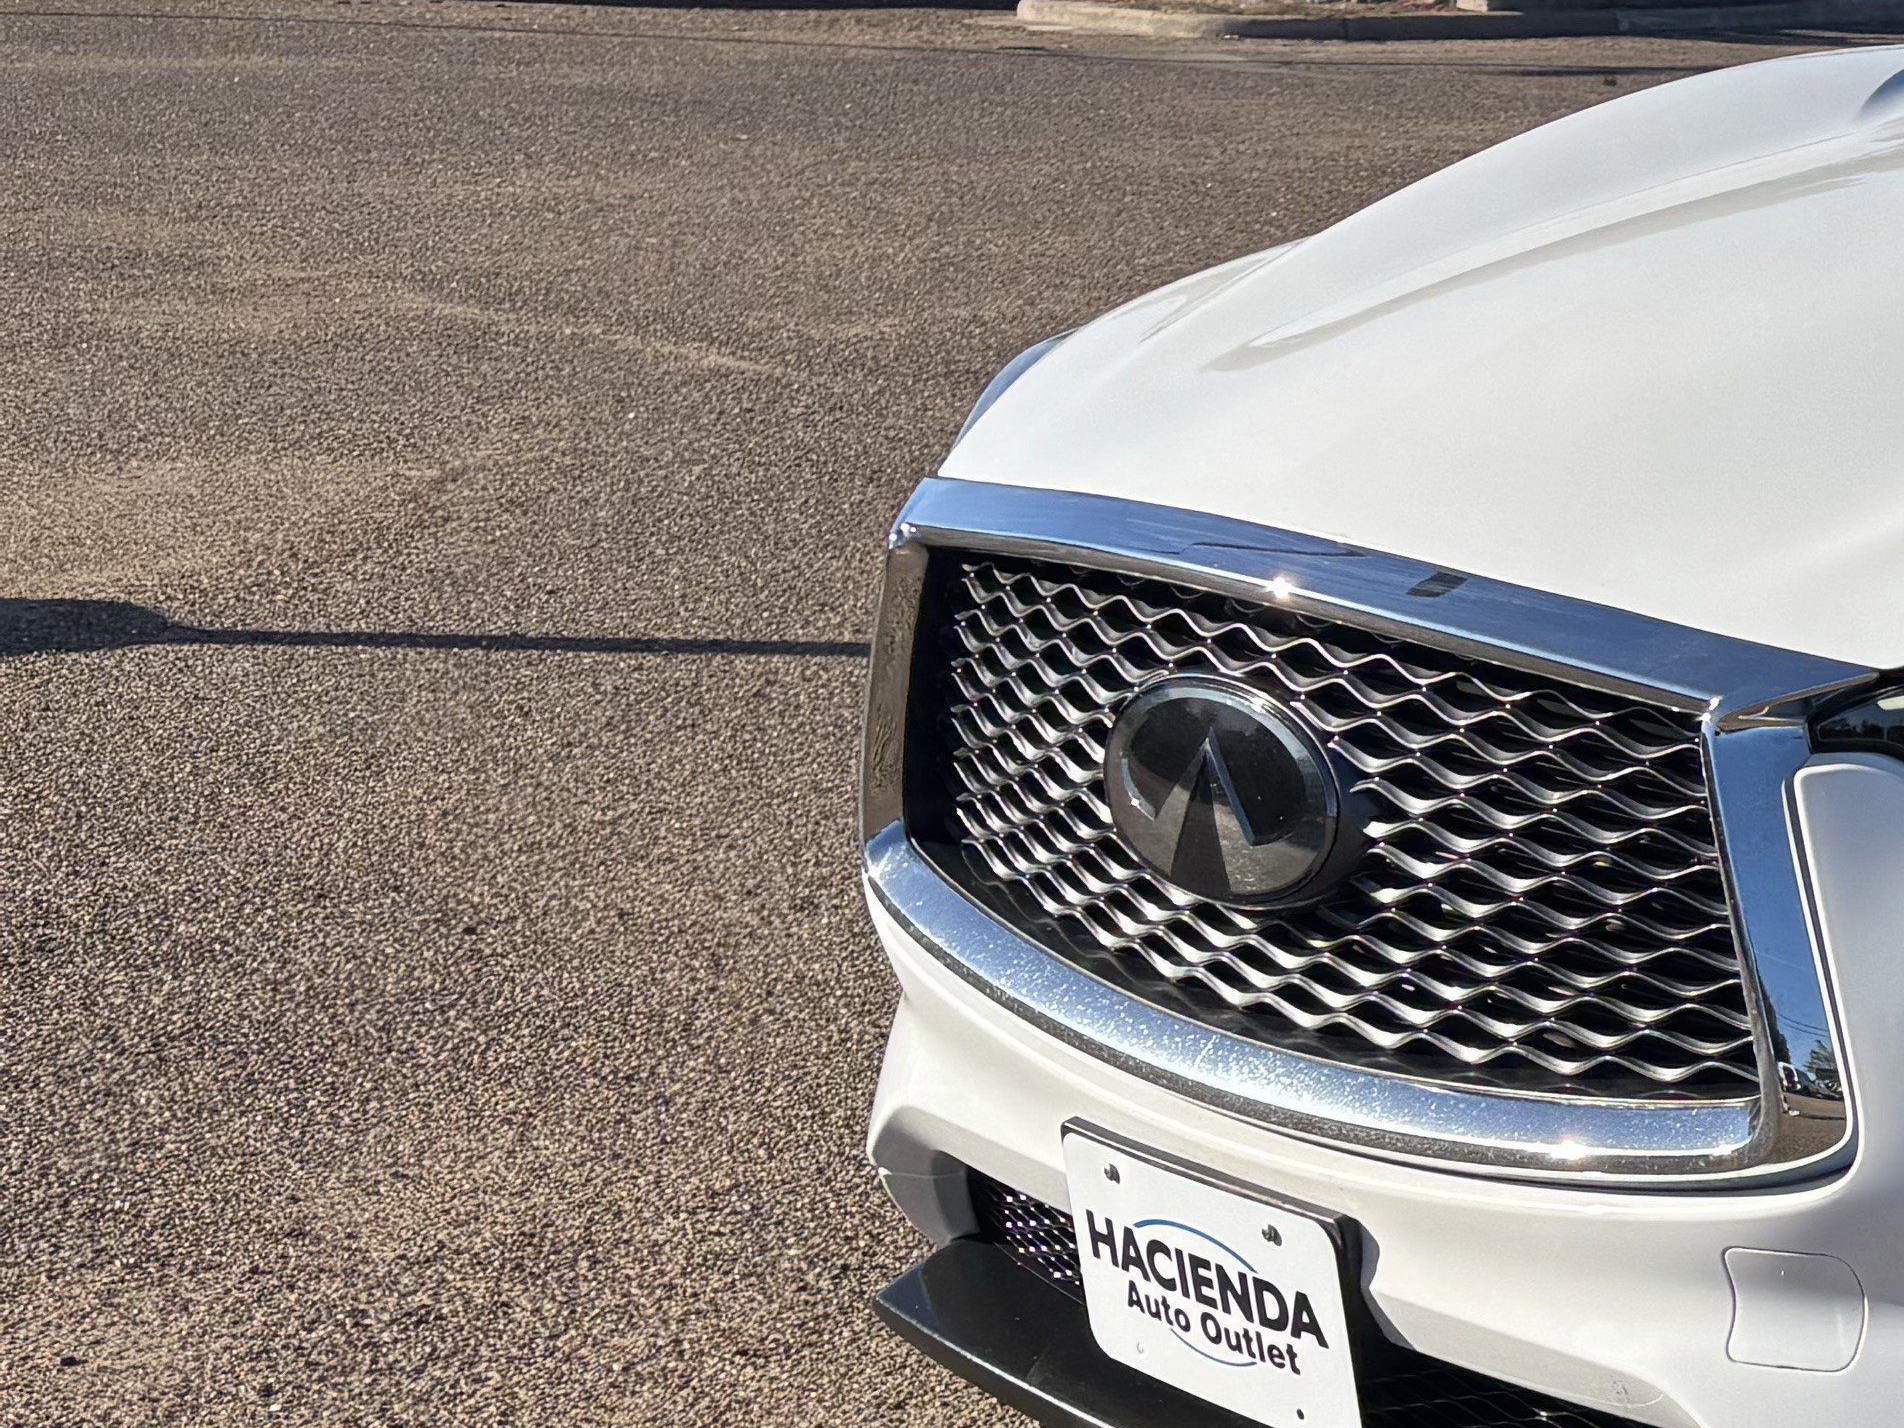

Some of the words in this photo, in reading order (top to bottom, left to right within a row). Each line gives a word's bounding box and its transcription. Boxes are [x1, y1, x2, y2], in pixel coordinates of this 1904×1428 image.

[1084, 1208, 1330, 1350] HACIENDA
[1126, 1279, 1191, 1333] Auto
[1199, 1311, 1302, 1376] Outlet
